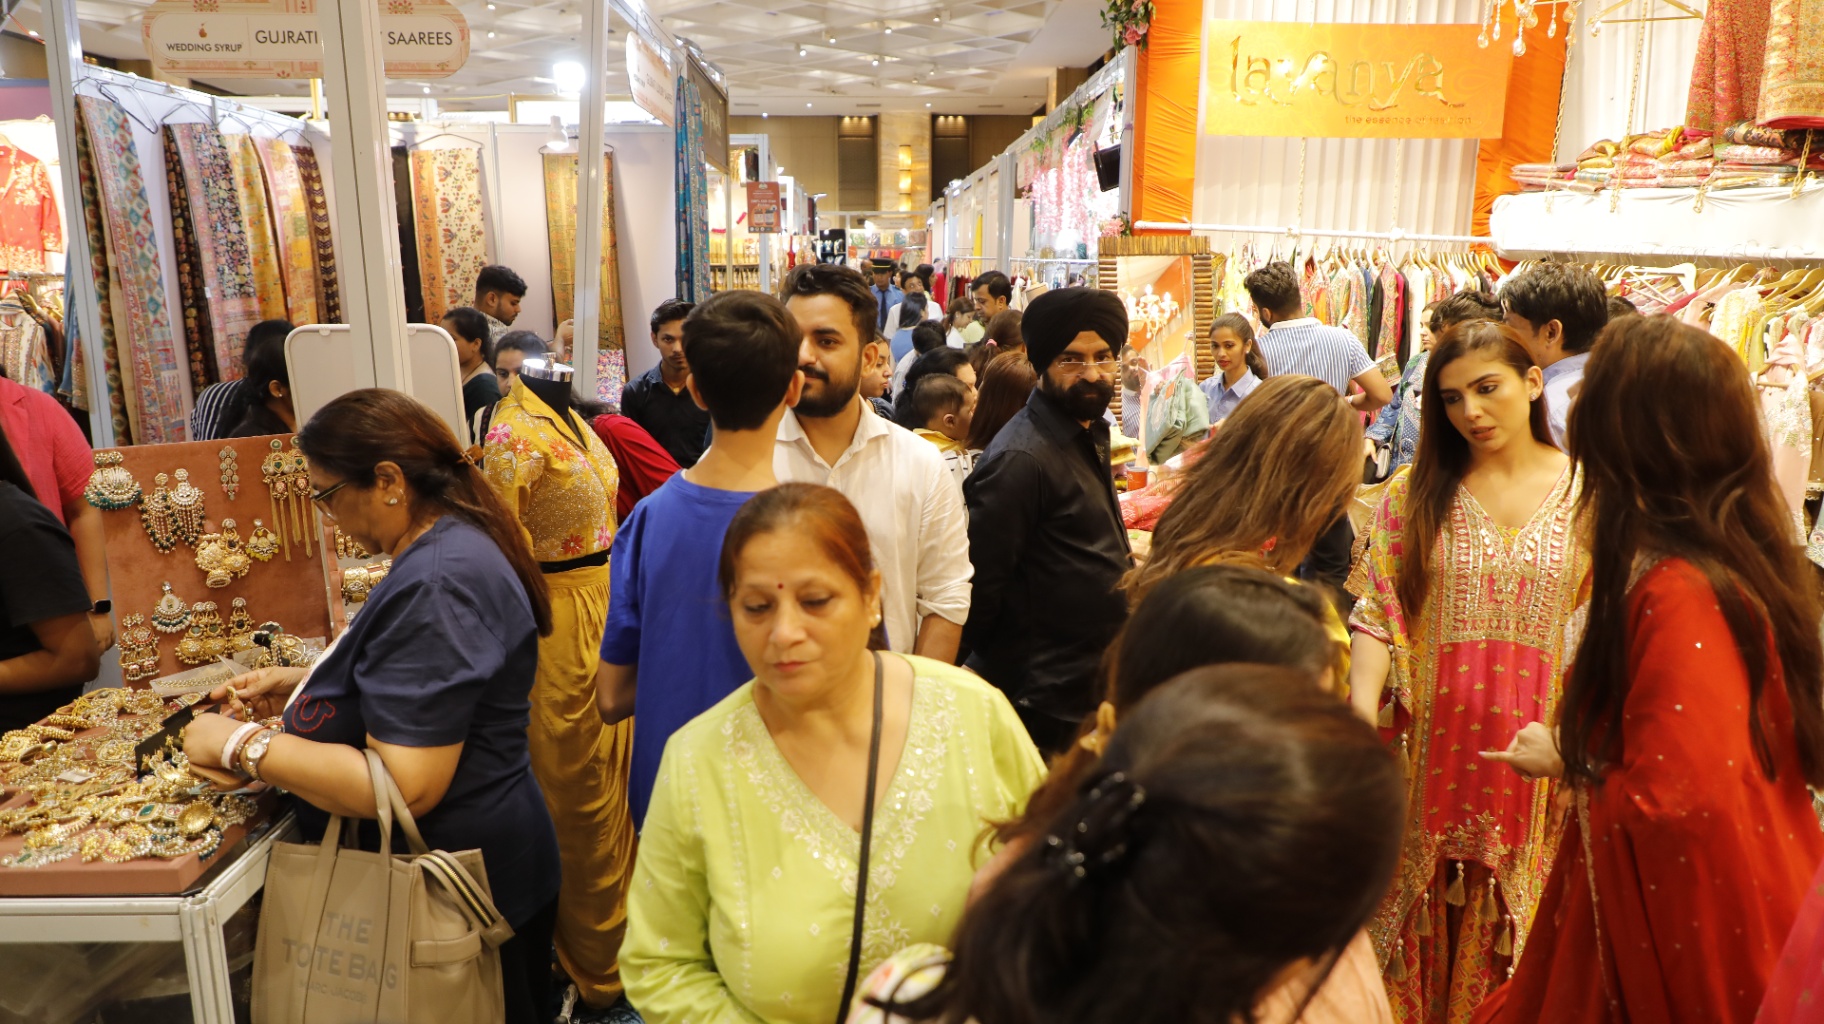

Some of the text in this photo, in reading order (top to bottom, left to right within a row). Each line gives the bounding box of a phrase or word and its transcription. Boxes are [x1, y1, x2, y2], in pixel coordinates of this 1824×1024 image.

[255, 30, 318, 44] GUJRATI
[388, 31, 453, 46] SAAREES
[166, 43, 243, 52] WEDDING SYRUP
[1229, 35, 1465, 111] lavanya
[1344, 115, 1362, 124] the
[1365, 115, 1412, 125] essence
[1415, 114, 1428, 125] of
[326, 911, 372, 945] THE
[281, 937, 398, 990] TOTE BAG
